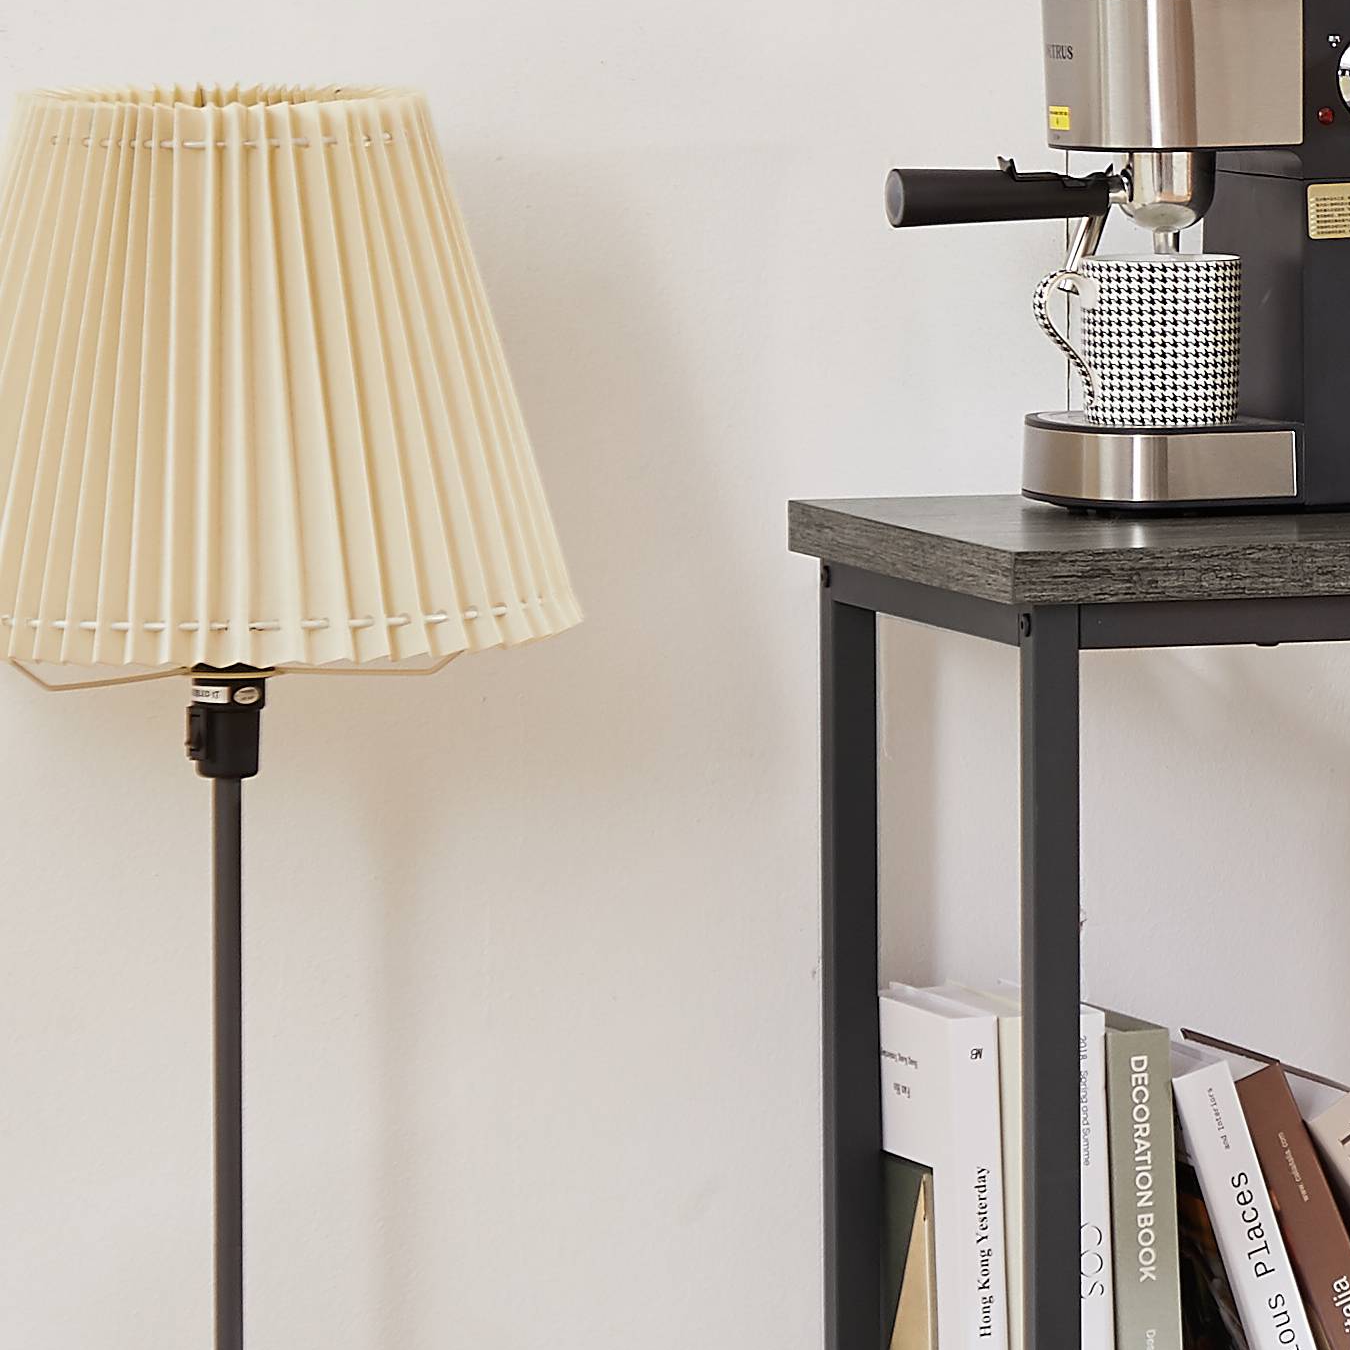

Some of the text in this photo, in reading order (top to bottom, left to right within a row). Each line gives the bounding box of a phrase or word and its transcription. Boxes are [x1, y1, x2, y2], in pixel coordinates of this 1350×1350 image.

[1082, 1105, 1090, 1126] and
[1207, 1088, 1231, 1150] and Interiors
[1130, 1055, 1157, 1282] DECORATION BOOK
[973, 1166, 994, 1339] Hong Kong Yesterday
[1080, 1221, 1105, 1299] COS
[1231, 1171, 1276, 1278] Places
